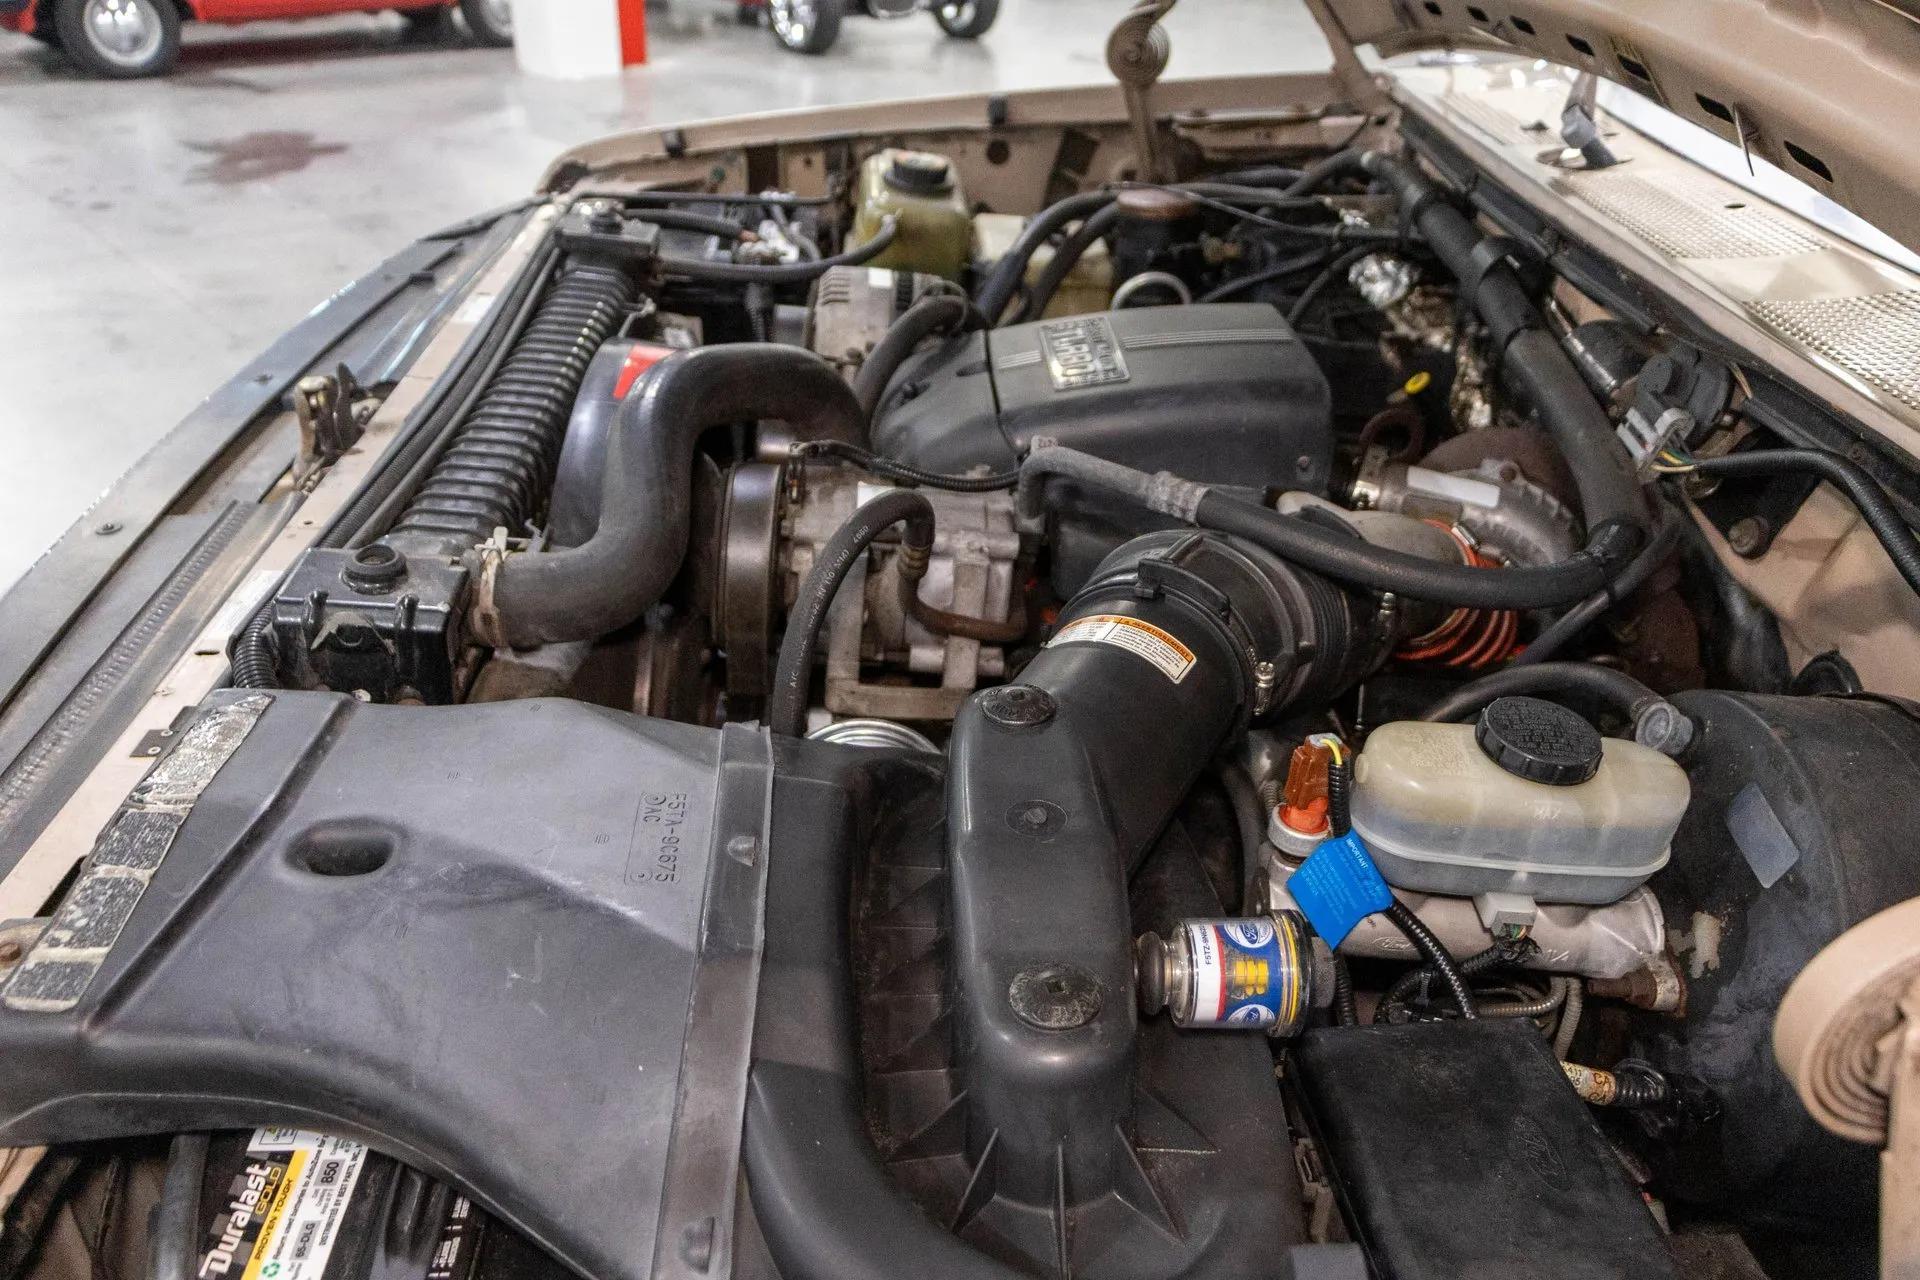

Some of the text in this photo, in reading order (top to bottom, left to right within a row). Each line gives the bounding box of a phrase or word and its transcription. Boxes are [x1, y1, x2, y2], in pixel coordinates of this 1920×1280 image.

[655, 793, 687, 882] F5TA-9C675
[1346, 838, 1369, 869] IMPORTANT
[255, 1167, 282, 1215] GOLD
[307, 1149, 322, 1179] AutoZone
[199, 1164, 272, 1278] Duralast
[255, 1179, 293, 1260] PROVEN TOUGH
